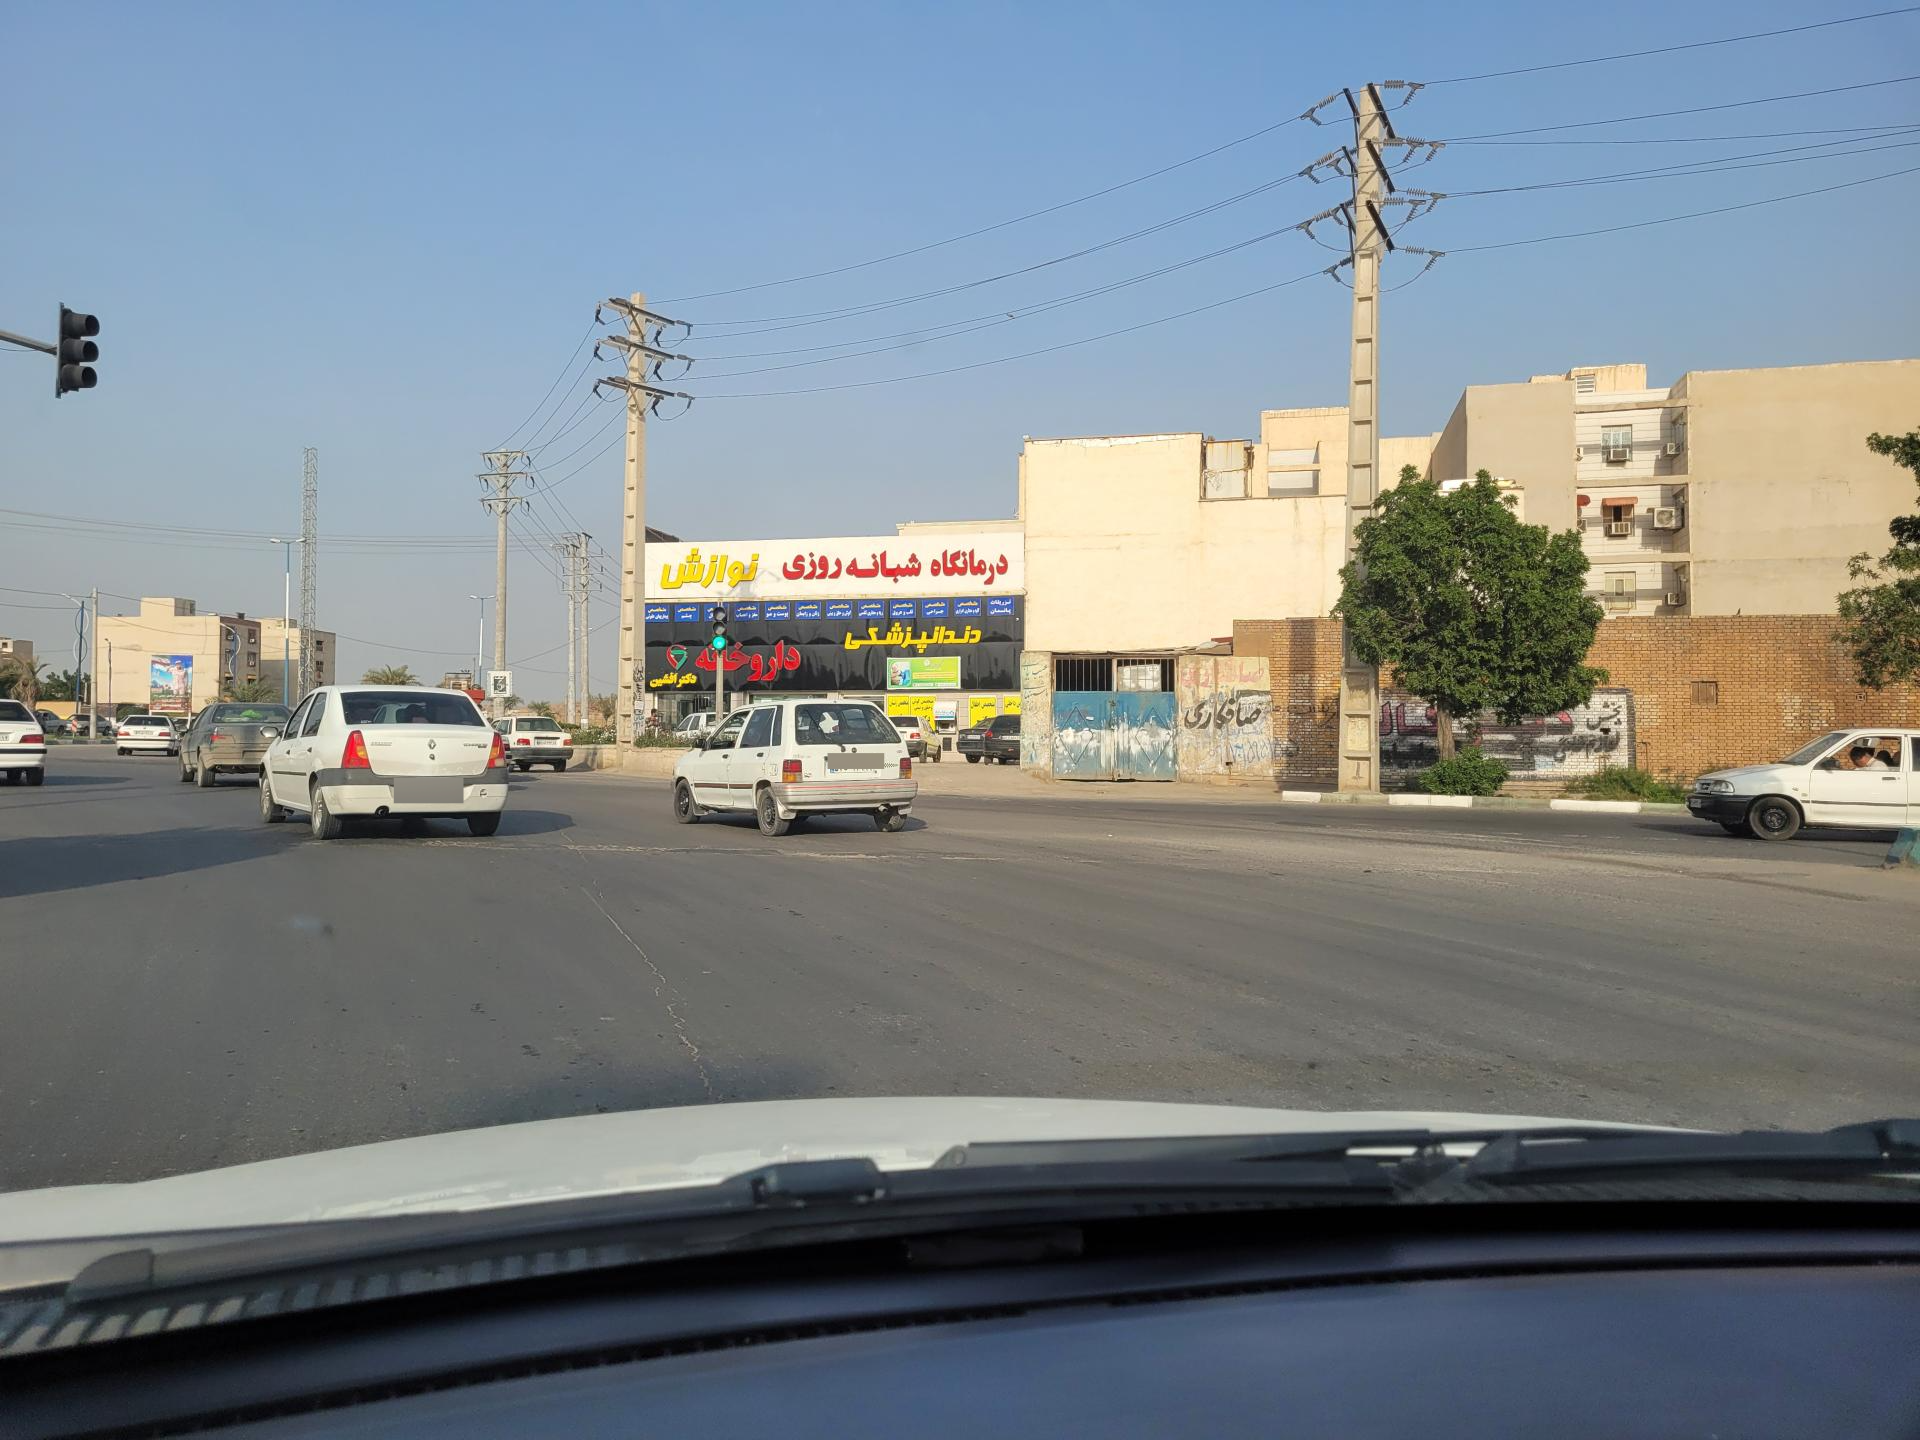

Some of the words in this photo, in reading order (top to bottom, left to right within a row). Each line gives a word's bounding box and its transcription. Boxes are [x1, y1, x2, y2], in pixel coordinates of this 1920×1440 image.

[660, 547, 760, 589] نوازش
[782, 552, 843, 580] روزی
[845, 550, 922, 583] شبانه
[930, 548, 1009, 585] درمانگاه
[844, 622, 982, 654] دندانپزشکی
[695, 640, 801, 682] داروخانه
[649, 672, 678, 688] افشین
[676, 673, 698, 688] دکتر
[1184, 697, 1262, 730] صافکاری
